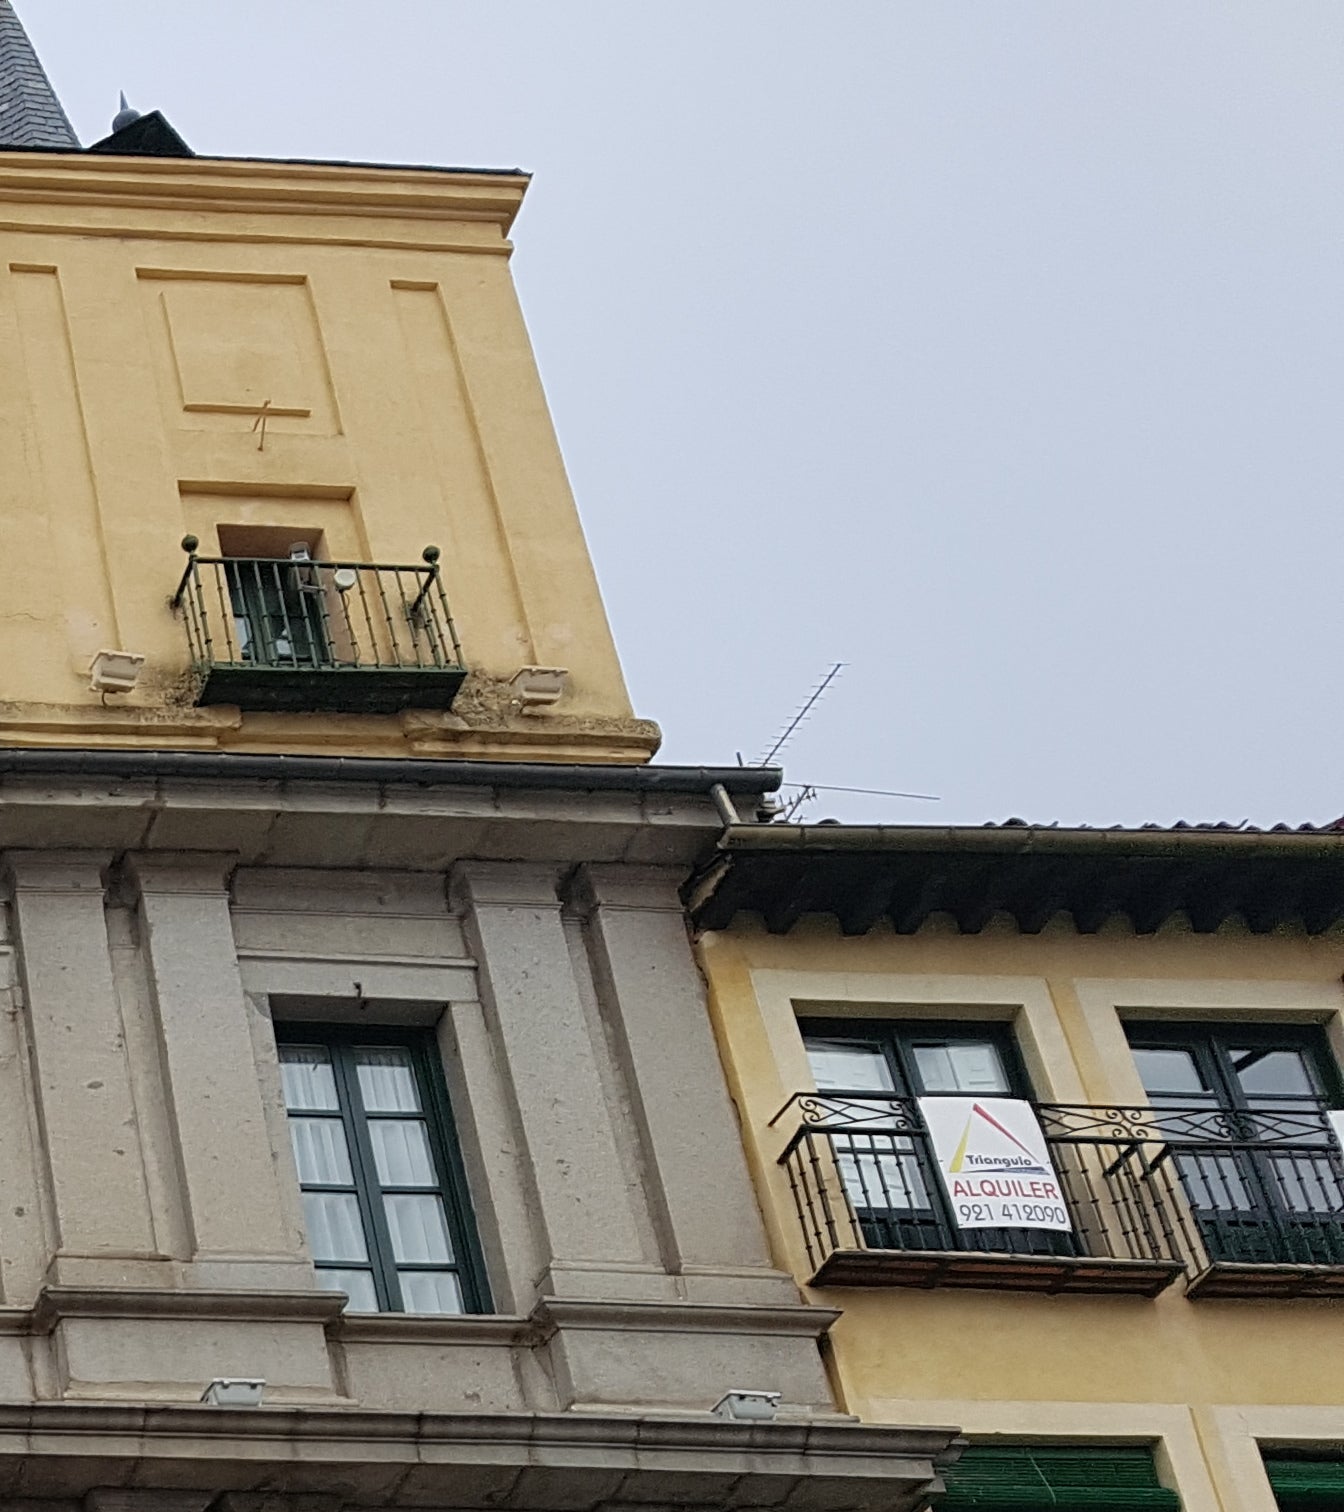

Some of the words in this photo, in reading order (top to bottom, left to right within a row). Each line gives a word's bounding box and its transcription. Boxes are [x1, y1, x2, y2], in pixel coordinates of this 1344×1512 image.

[954, 1180, 1058, 1199] ALQUILER
[960, 1204, 994, 1220] 921
[1002, 1204, 1065, 1224] 412090
